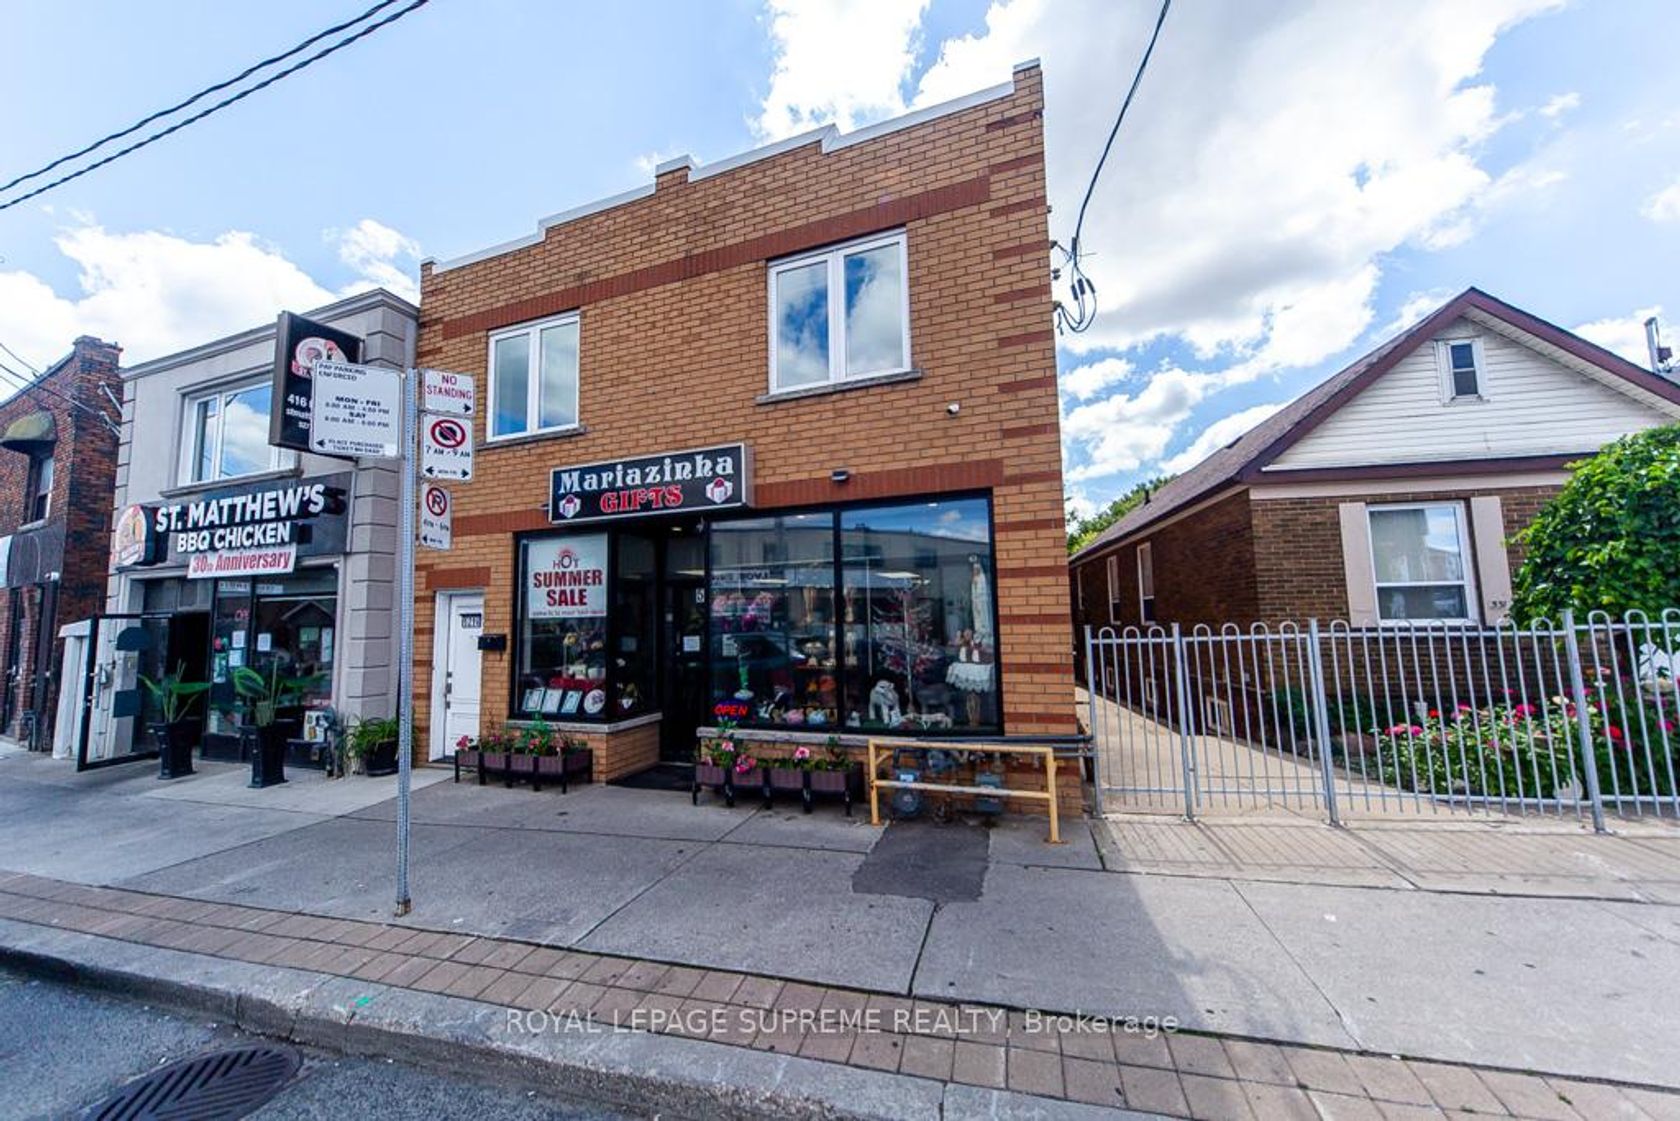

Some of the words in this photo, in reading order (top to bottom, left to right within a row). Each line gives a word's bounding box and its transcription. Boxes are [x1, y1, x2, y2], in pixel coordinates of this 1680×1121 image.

[441, 374, 457, 386] NO
[426, 384, 472, 400] STANDING
[287, 394, 307, 408] 416
[335, 396, 358, 404] MON
[365, 399, 381, 407] FRI
[349, 411, 366, 419] SAT
[433, 447, 444, 455] AM
[460, 450, 470, 458] AM
[558, 454, 734, 494] Mariazinha
[600, 484, 683, 513] GIFTS
[155, 505, 182, 532] ST.
[187, 484, 325, 528] MATTHEW'S
[177, 530, 211, 552] BBQ
[213, 522, 290, 549] CHICKEN
[215, 550, 291, 574] Anniversary
[552, 554, 579, 570] HOT
[533, 569, 603, 588] SUMMER
[546, 588, 588, 607] SALE
[714, 703, 749, 717] OPEN
